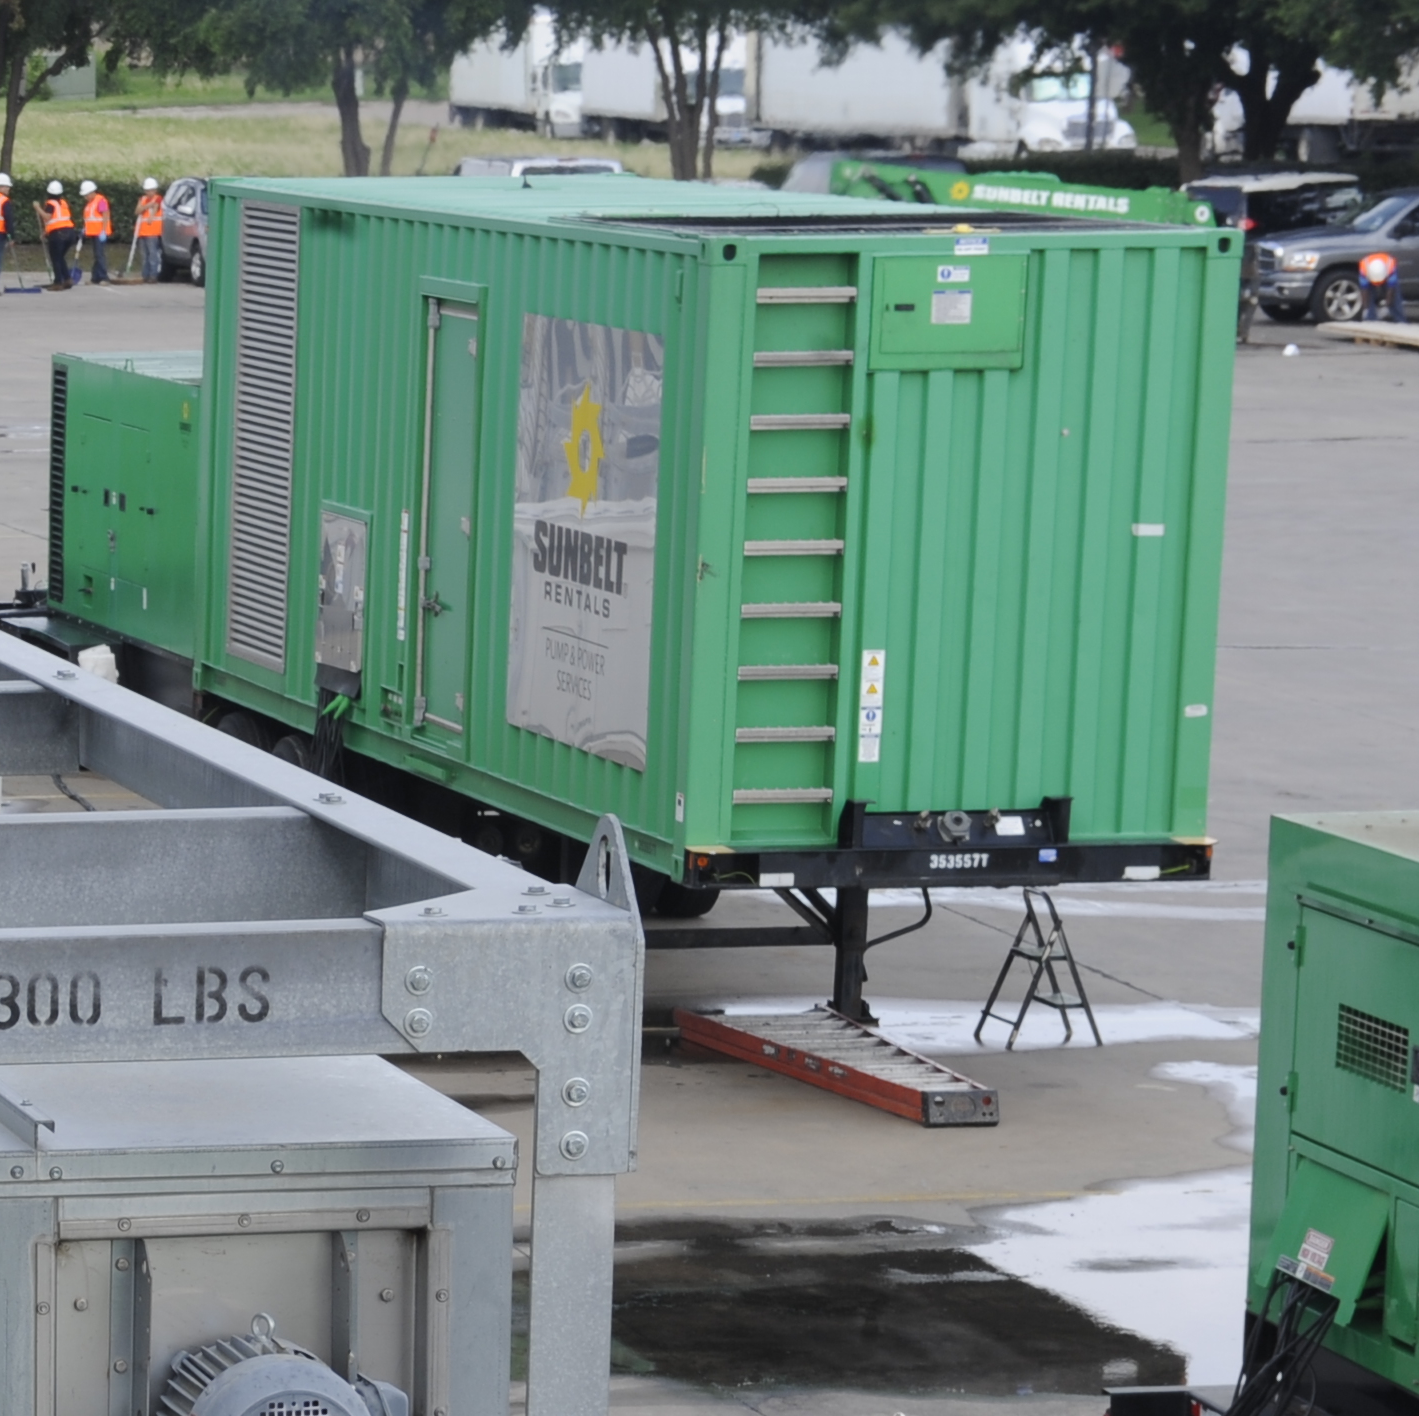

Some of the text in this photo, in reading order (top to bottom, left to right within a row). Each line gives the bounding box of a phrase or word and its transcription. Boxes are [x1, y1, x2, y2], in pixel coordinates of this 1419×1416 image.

[973, 184, 1130, 214] SUNBELT RENTALS
[532, 519, 628, 596] SUNBELT
[543, 581, 611, 619] RENTALS
[545, 637, 569, 663] PUMP
[577, 649, 606, 677] POWER
[556, 669, 592, 701] SERVICES
[929, 853, 989, 869] 353557T
[153, 964, 270, 1025] LBS
